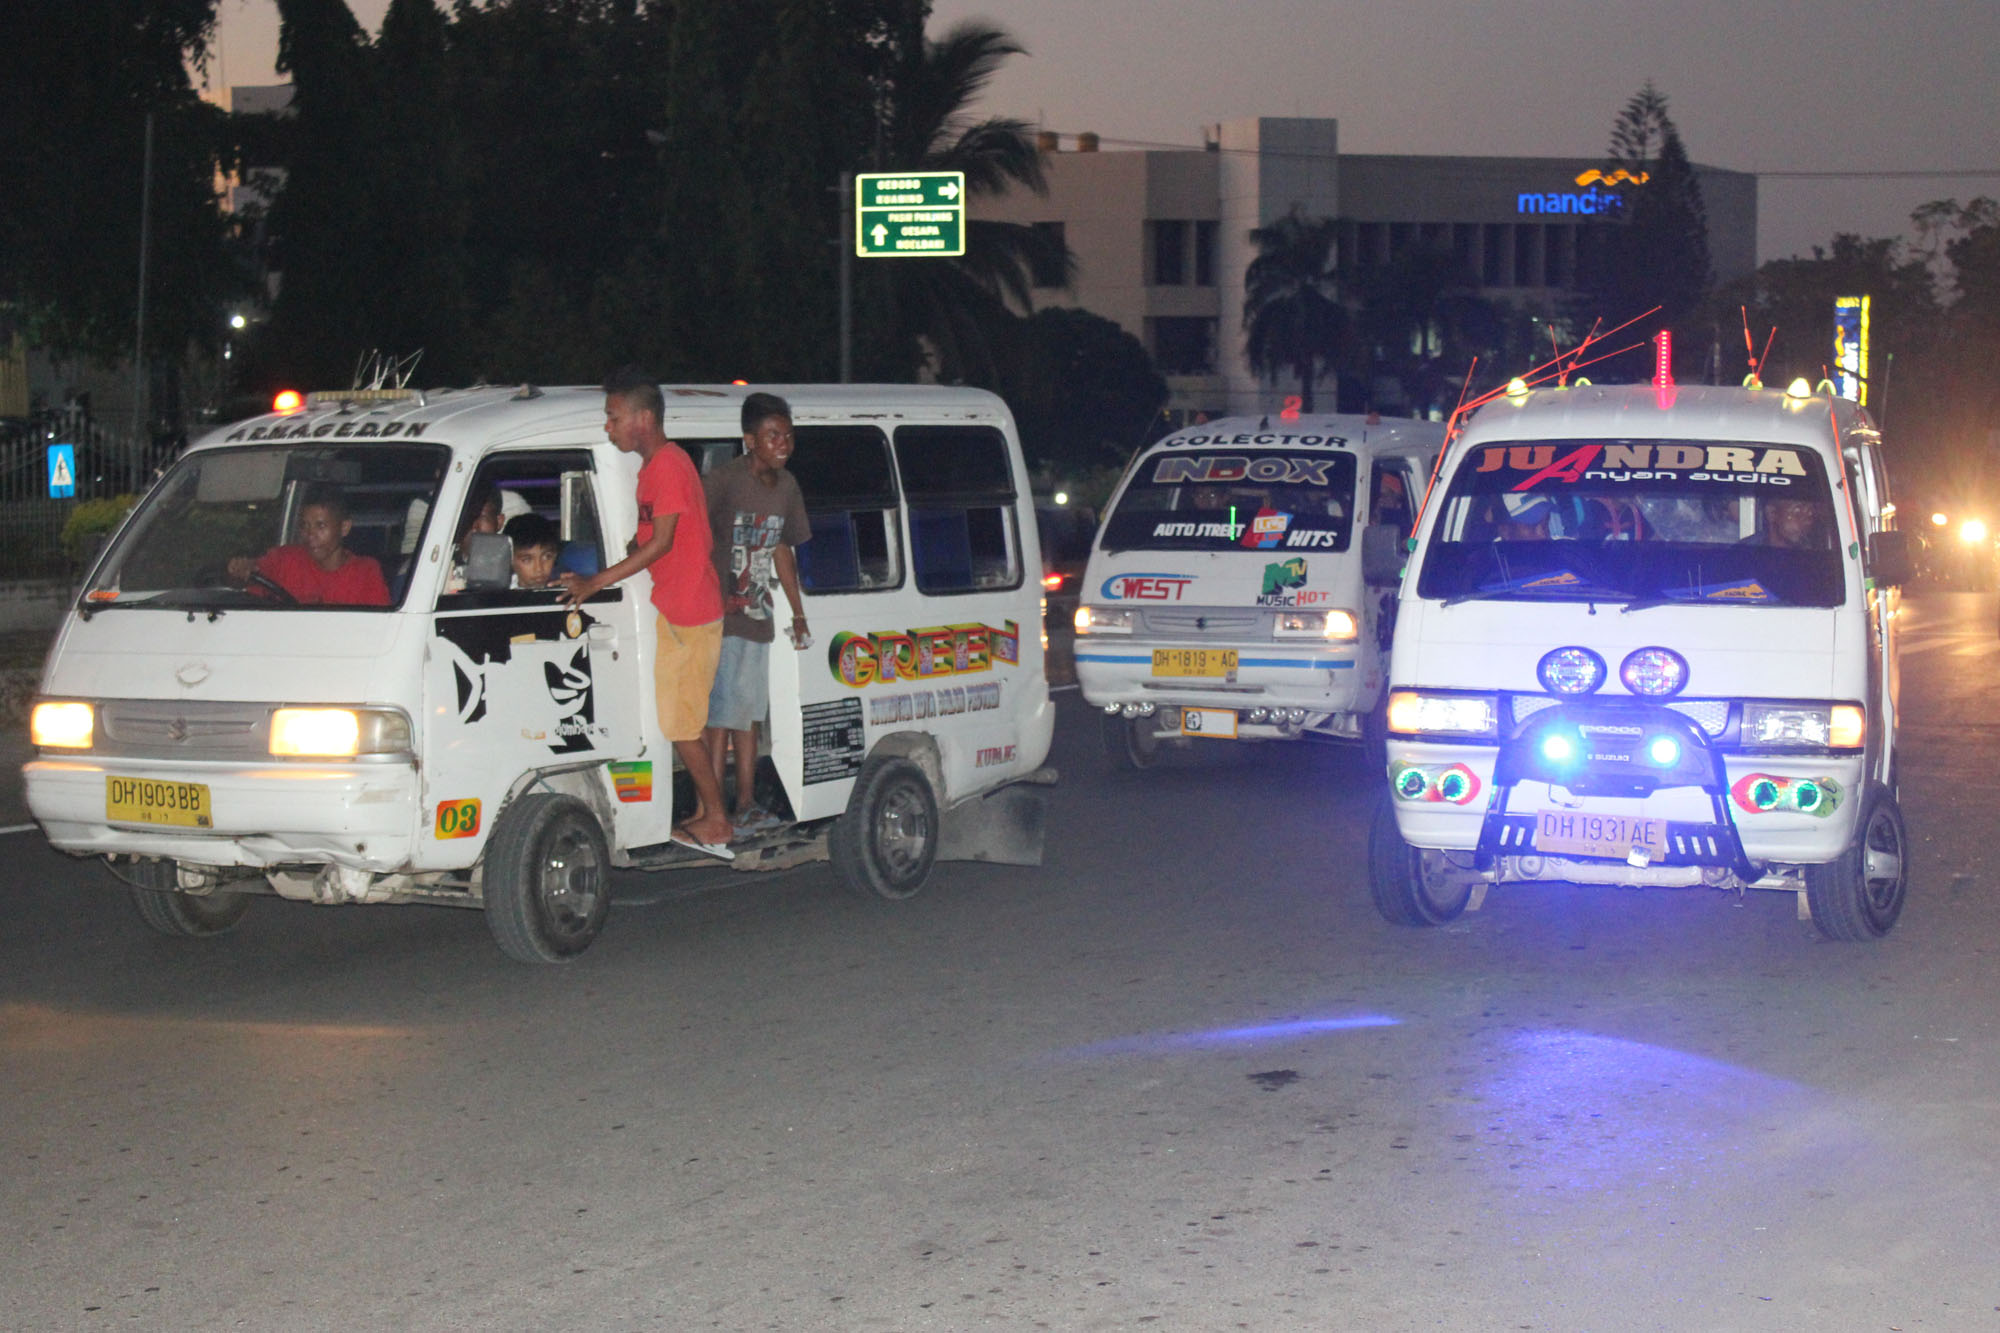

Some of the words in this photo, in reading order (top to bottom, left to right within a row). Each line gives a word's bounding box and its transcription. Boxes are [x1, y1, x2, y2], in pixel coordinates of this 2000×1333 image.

[1165, 433, 1349, 448] COLECTOR
[1153, 456, 1336, 486] INBOX
[1689, 471, 1792, 486] audio
[1153, 523, 1196, 537] AUTO
[1286, 530, 1337, 548] HITS
[1256, 595, 1296, 607] MUSIC
[1296, 591, 1331, 607] HOT
[828, 619, 1020, 689] GREEN
[440, 804, 477, 833] 03
